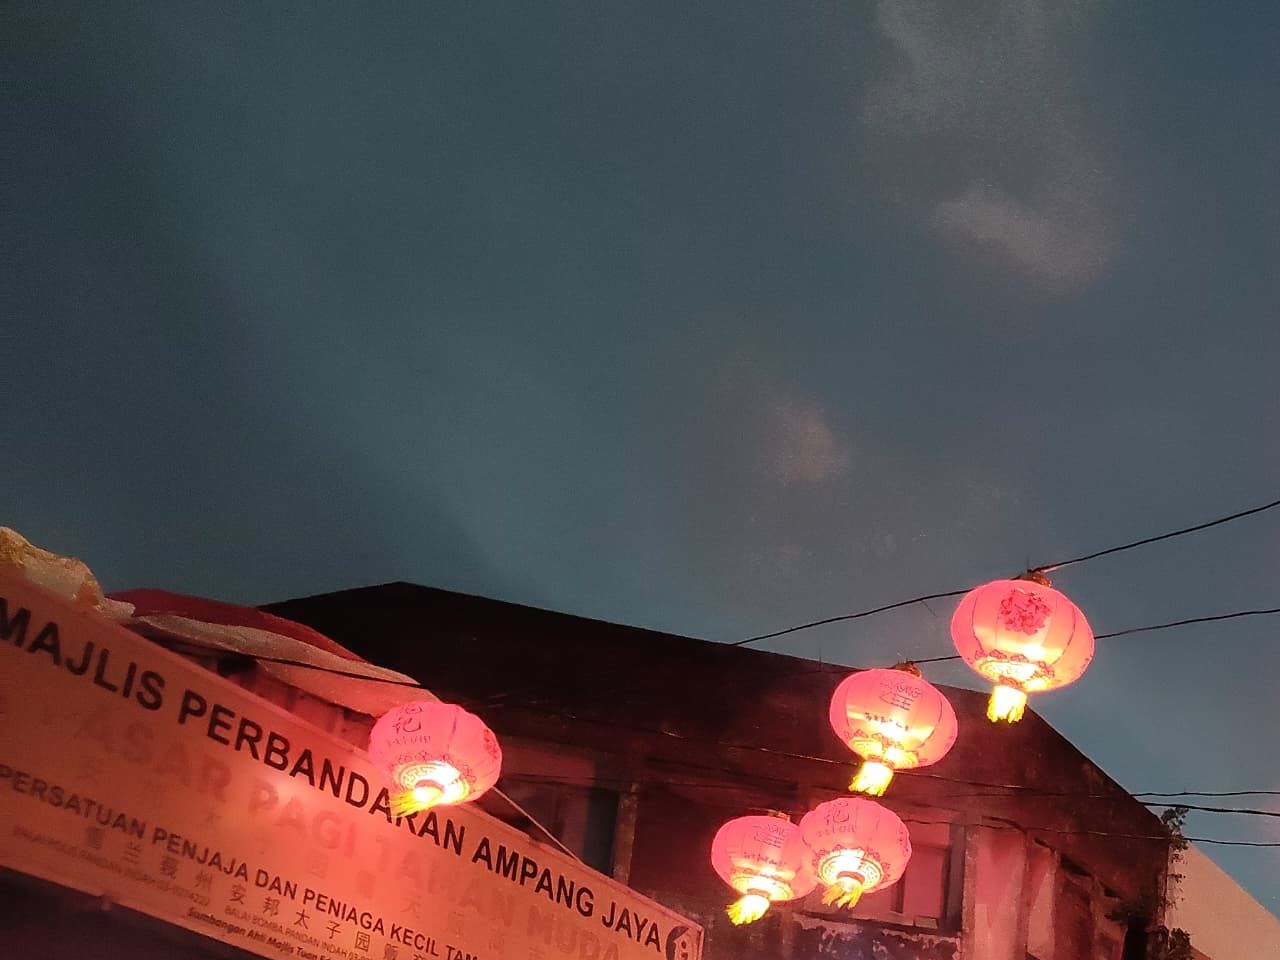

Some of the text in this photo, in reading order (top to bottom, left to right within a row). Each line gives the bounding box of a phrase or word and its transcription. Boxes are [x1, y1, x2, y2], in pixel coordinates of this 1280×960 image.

[0, 597, 165, 711] MAJLIS
[472, 837, 595, 917] AMPANG
[602, 902, 662, 952] JAYA
[0, 763, 147, 840] PERSATUAN
[152, 827, 249, 882] PENJAJA
[255, 869, 298, 900] DAN
[303, 888, 385, 936] PENIAGA
[390, 923, 440, 957] KECIL
